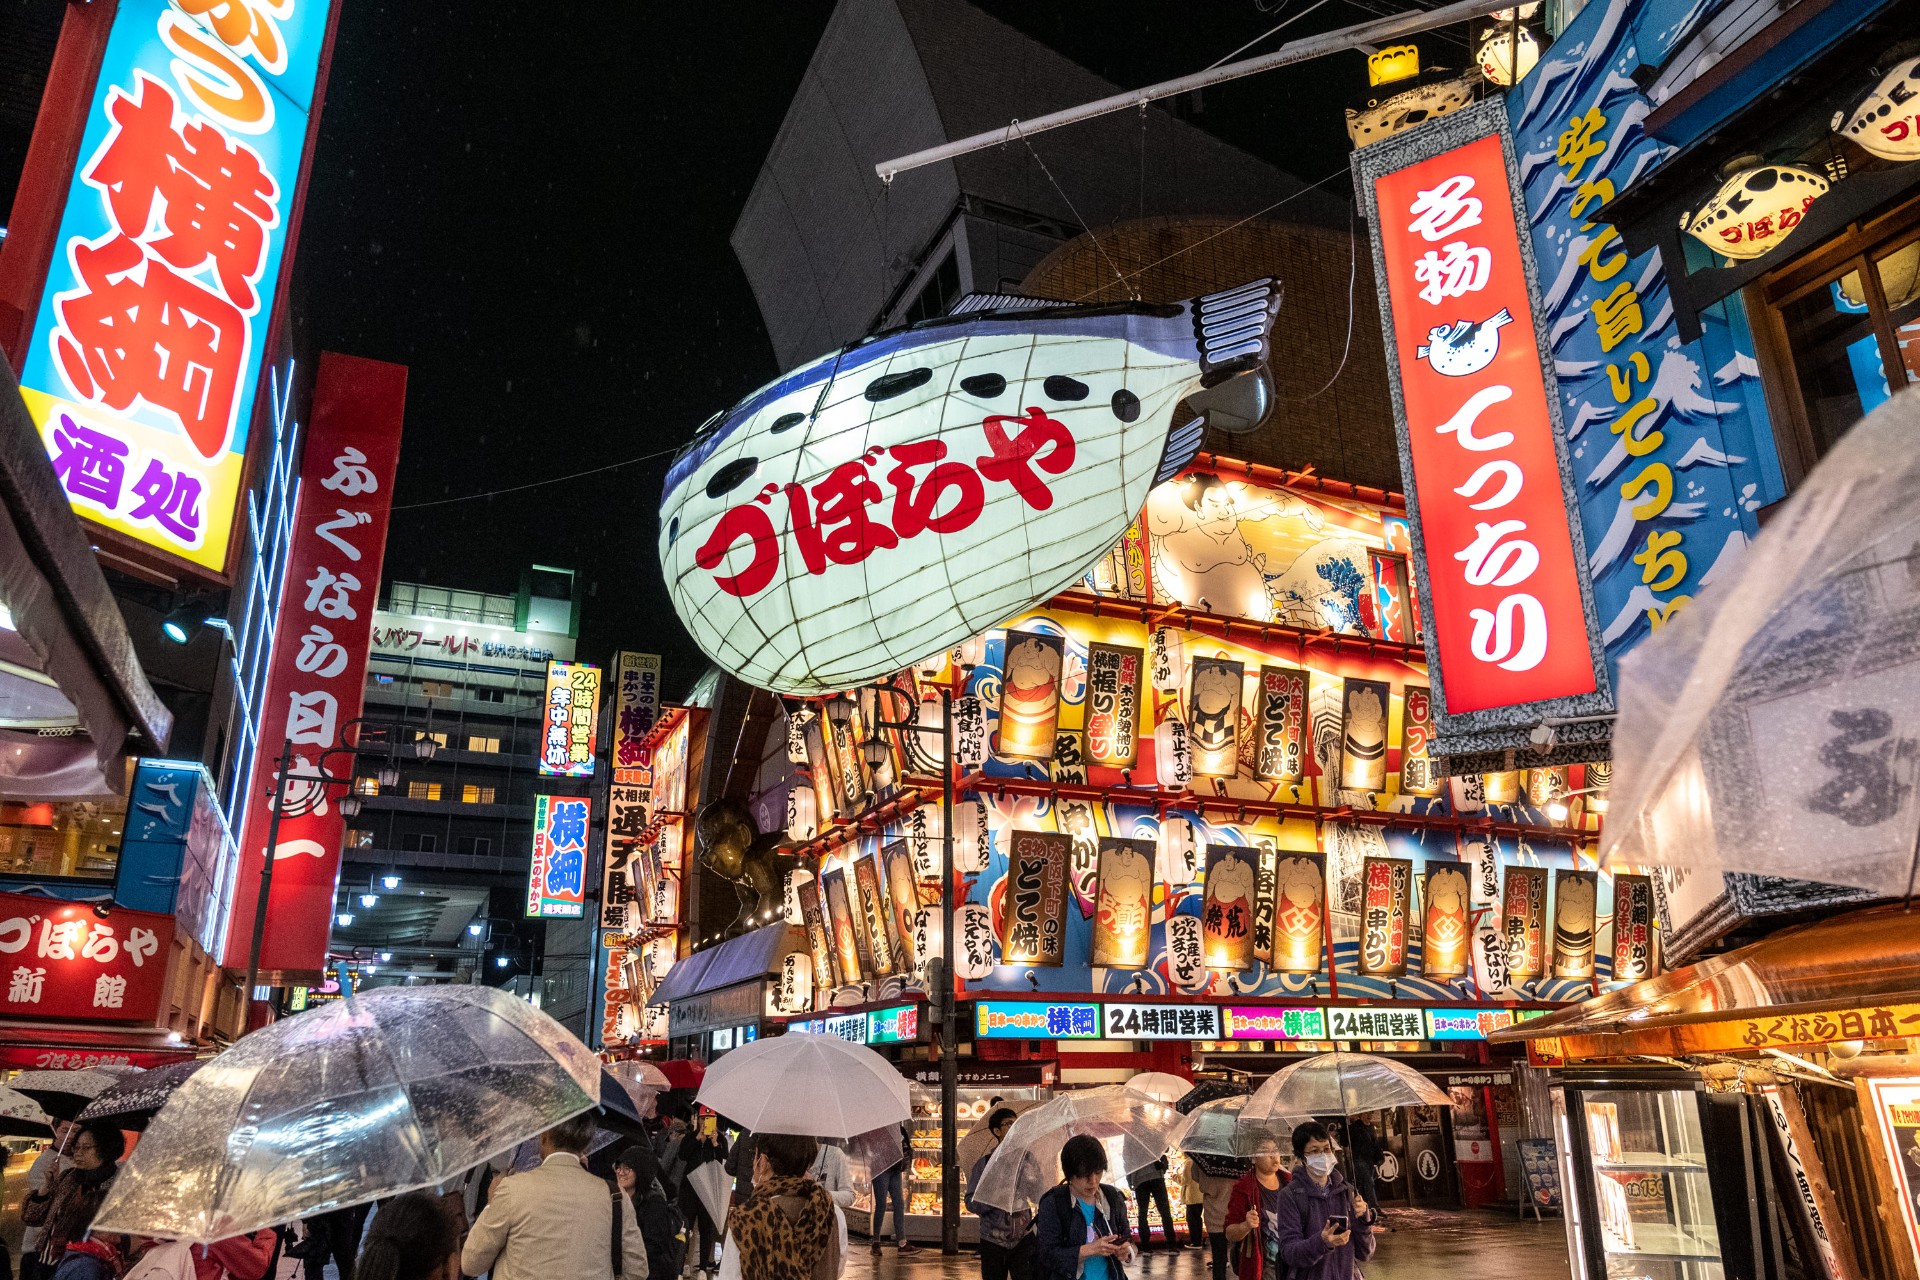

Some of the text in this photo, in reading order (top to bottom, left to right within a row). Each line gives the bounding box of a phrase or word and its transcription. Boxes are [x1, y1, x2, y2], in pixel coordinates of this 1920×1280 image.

[57, 74, 275, 457] 横綱
[1408, 175, 1493, 306] 名物
[1719, 195, 1816, 243] づぼらや
[52, 414, 203, 543] 酒処
[696, 406, 1076, 597] づぼらや
[261, 446, 378, 862] ふぐなら日本一
[622, 670, 640, 703] 串かつ
[640, 671, 655, 704] 日本一の
[546, 686, 571, 766] 年中無休
[568, 671, 598, 764] 24時間営業
[618, 704, 654, 769] 横綱
[1089, 669, 1117, 760] 握り盛り
[1115, 655, 1136, 758] 新鮮ネタが勢揃い
[1260, 672, 1290, 776] 名物 どて焼
[1287, 678, 1304, 775] 大阪下町の味
[1404, 691, 1430, 791] もつ鍋
[612, 787, 651, 803] 大相撲
[1055, 735, 1098, 892] 名物 串かつ
[529, 797, 547, 914] 新世界 日本一の串かつ
[547, 801, 588, 897] 横綱
[0, 914, 159, 967] づぼらや
[1010, 838, 1049, 957] 名物 どて焼
[1042, 842, 1065, 956] 大阪下町の味
[1365, 862, 1392, 970] 横綱串かつ
[1506, 873, 1529, 971] 横綱串かつ
[1615, 880, 1632, 975] 海の幸山の幸
[1632, 881, 1650, 976] 横綱串かつ
[8, 966, 127, 1009] 新館
[897, 1007, 918, 1040] 横綱
[988, 1012, 1046, 1028] 日本一の串かつ
[1046, 1006, 1097, 1036] 横綱
[1109, 1007, 1215, 1036] 24時間営業
[1233, 1015, 1282, 1030] 日本一の串かつ
[1282, 1010, 1323, 1037] 横綱
[1333, 1012, 1421, 1037] 24時間営業
[1434, 1011, 1511, 1036] 日本一の串かつ 横綱
